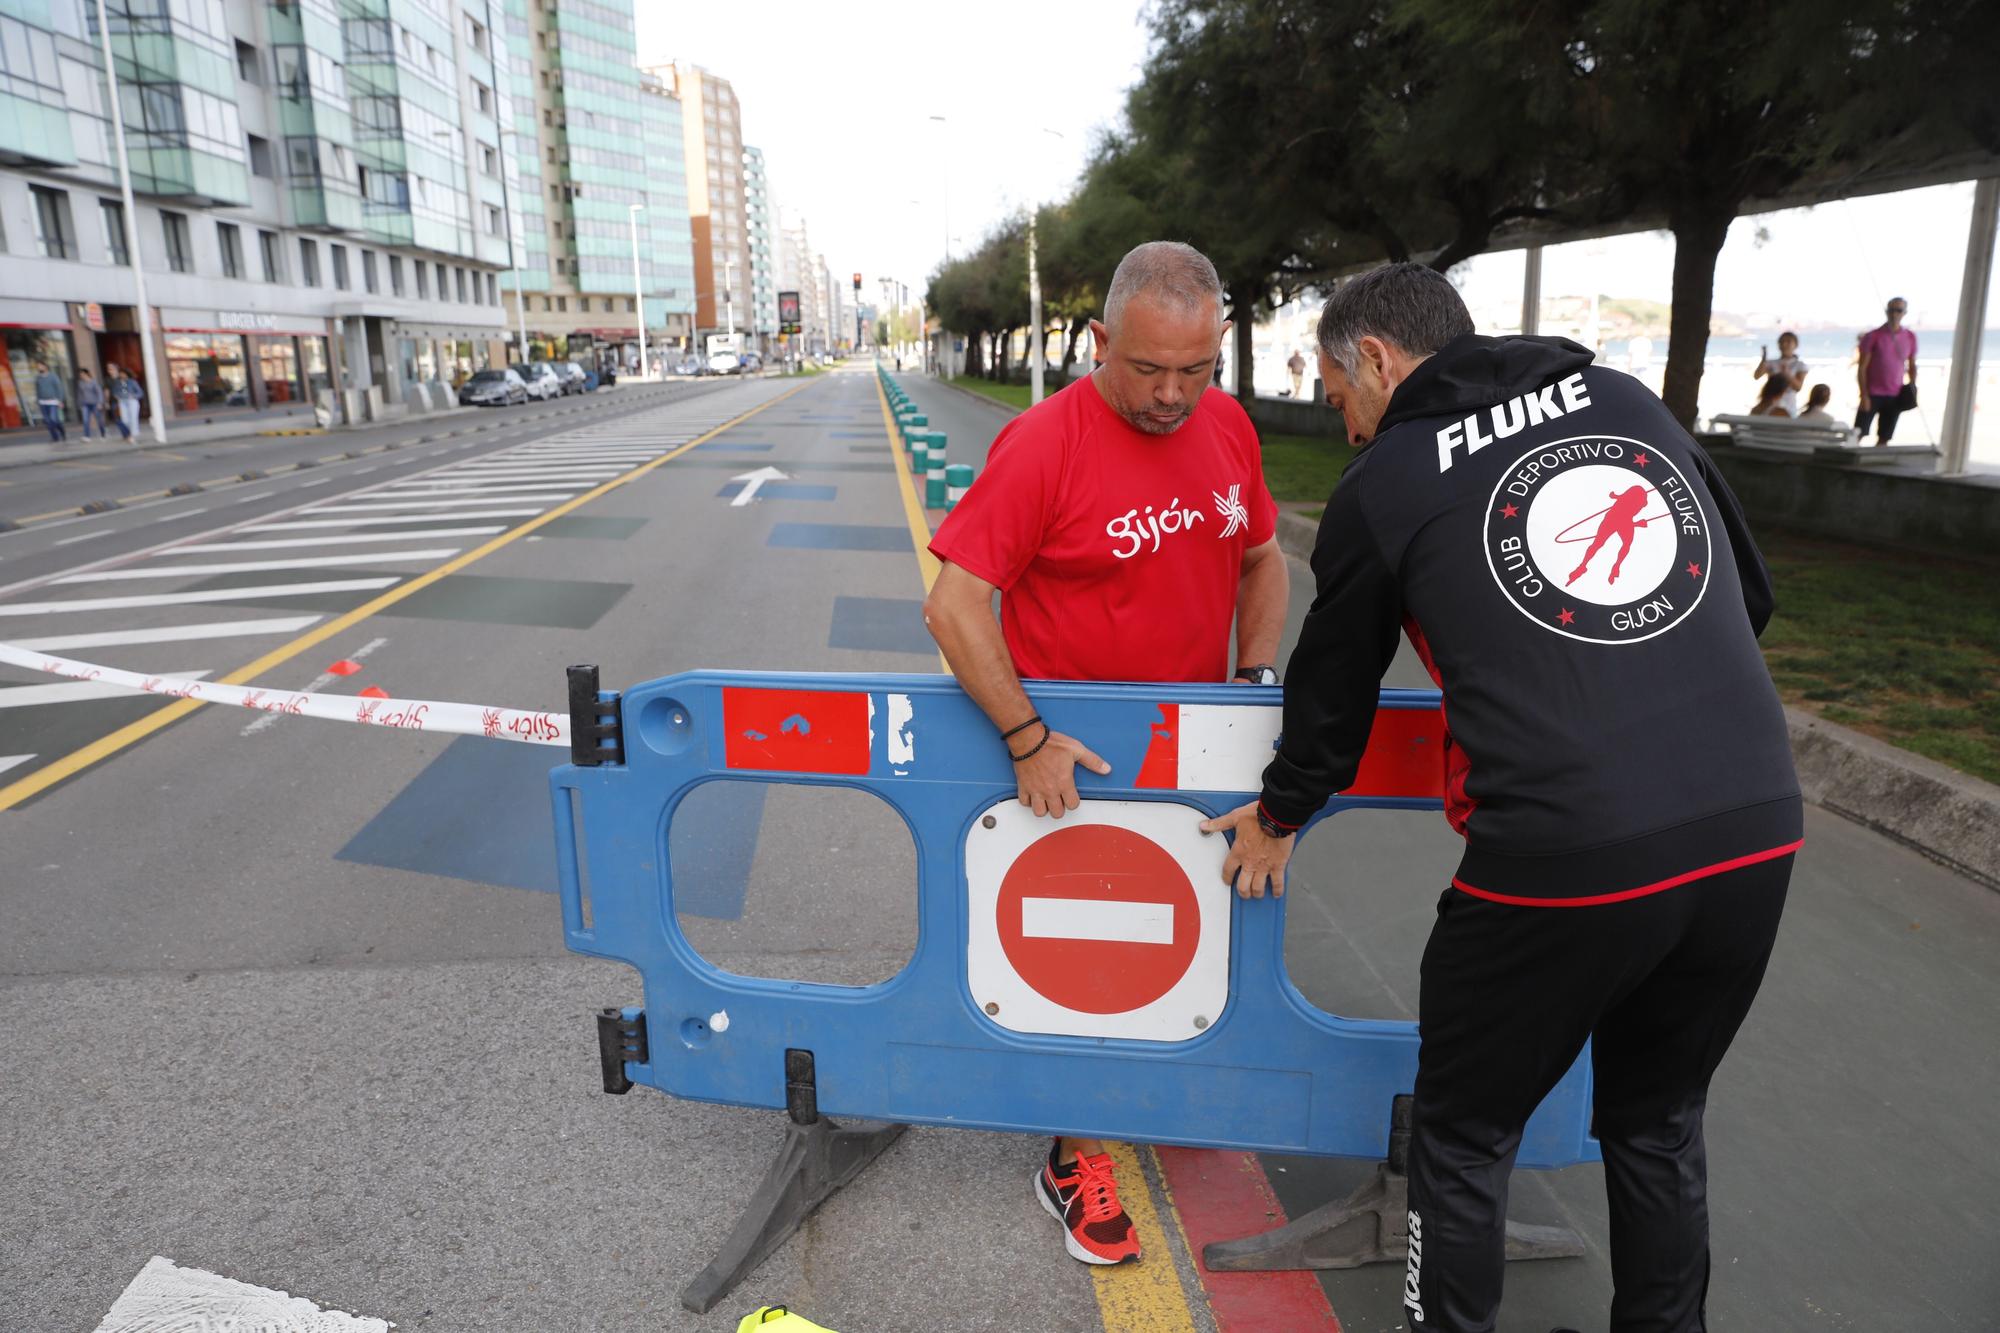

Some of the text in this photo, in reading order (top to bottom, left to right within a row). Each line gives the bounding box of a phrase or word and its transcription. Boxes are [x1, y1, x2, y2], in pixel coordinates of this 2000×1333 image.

[1437, 372, 1592, 474] FLUKE
[1106, 497, 1205, 559] gijón
[1500, 443, 1700, 631] CLUB DEPORTIVO FLUKE GIJON
